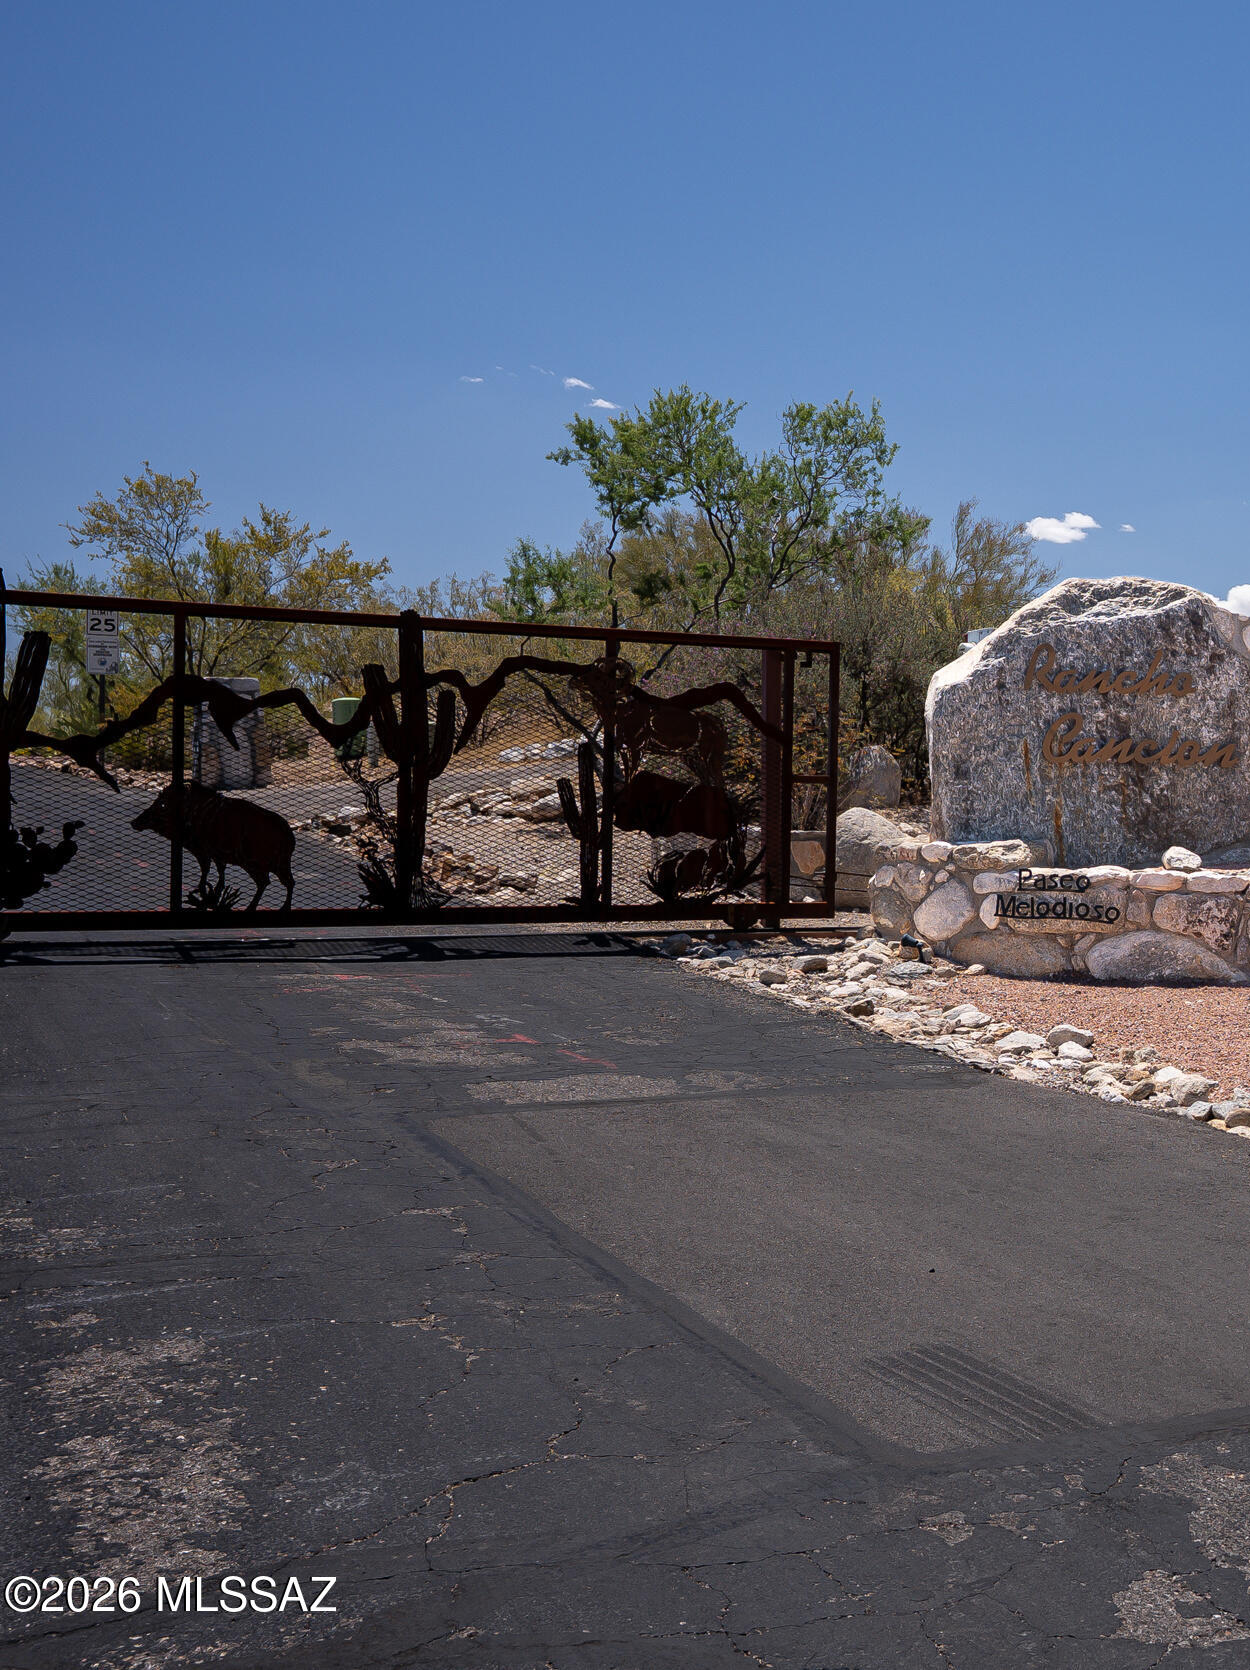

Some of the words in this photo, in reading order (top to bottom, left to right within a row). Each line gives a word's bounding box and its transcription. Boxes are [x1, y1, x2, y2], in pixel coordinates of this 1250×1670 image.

[90, 618, 116, 632] 25
[1024, 643, 1196, 697] Rancho
[1018, 868, 1091, 891] Paseo
[995, 894, 1120, 921] Melodioso
